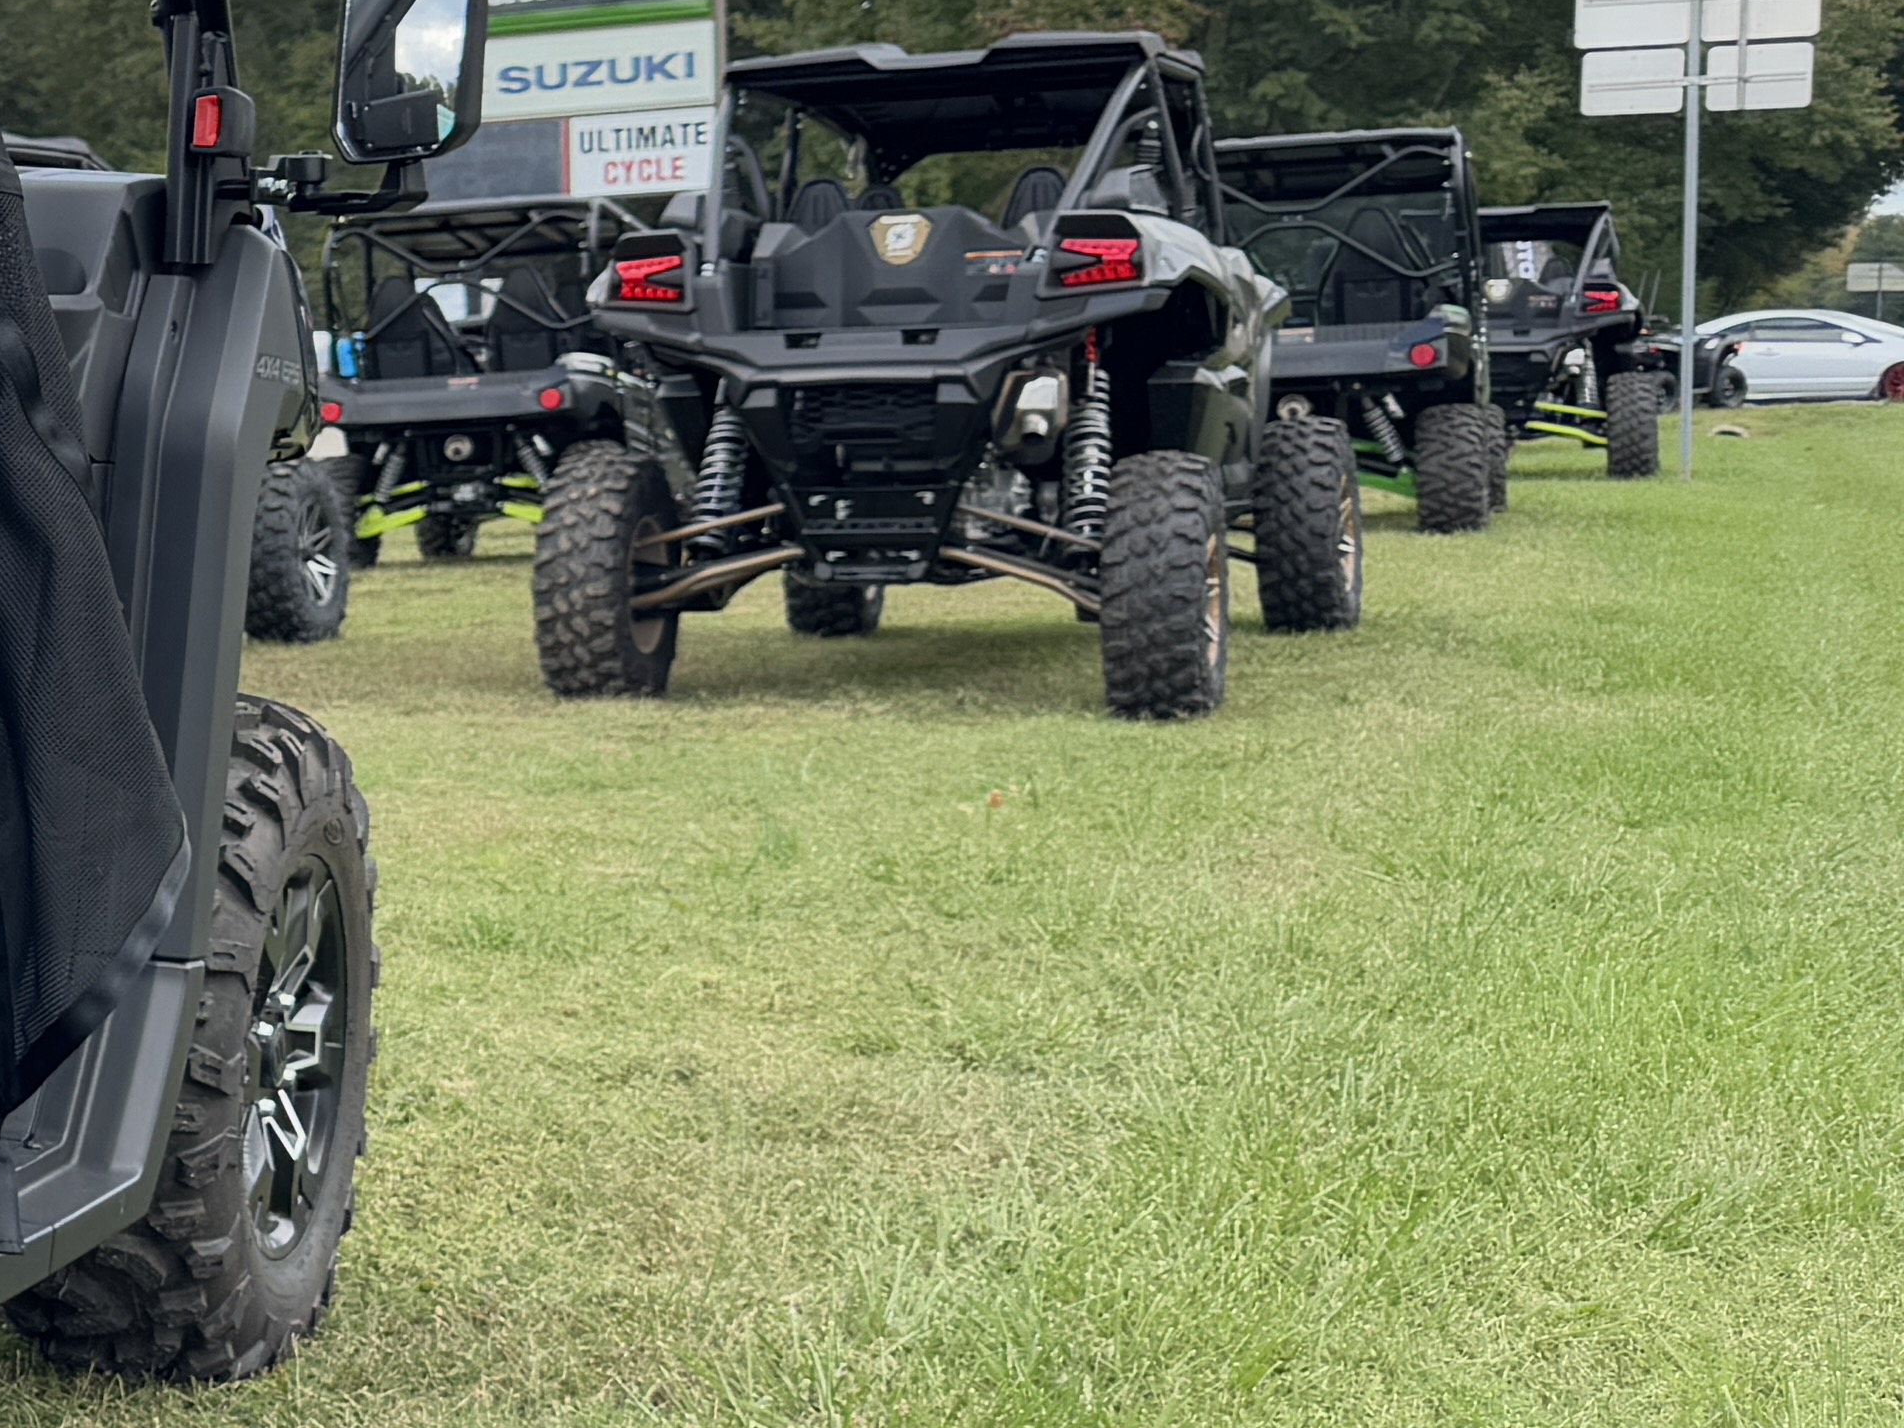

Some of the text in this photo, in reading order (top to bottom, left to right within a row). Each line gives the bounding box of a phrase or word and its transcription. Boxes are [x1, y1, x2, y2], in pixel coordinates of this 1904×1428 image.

[498, 51, 696, 95] SUZUKI
[579, 121, 709, 154] ULTIMATE
[603, 157, 687, 185] CYCLE
